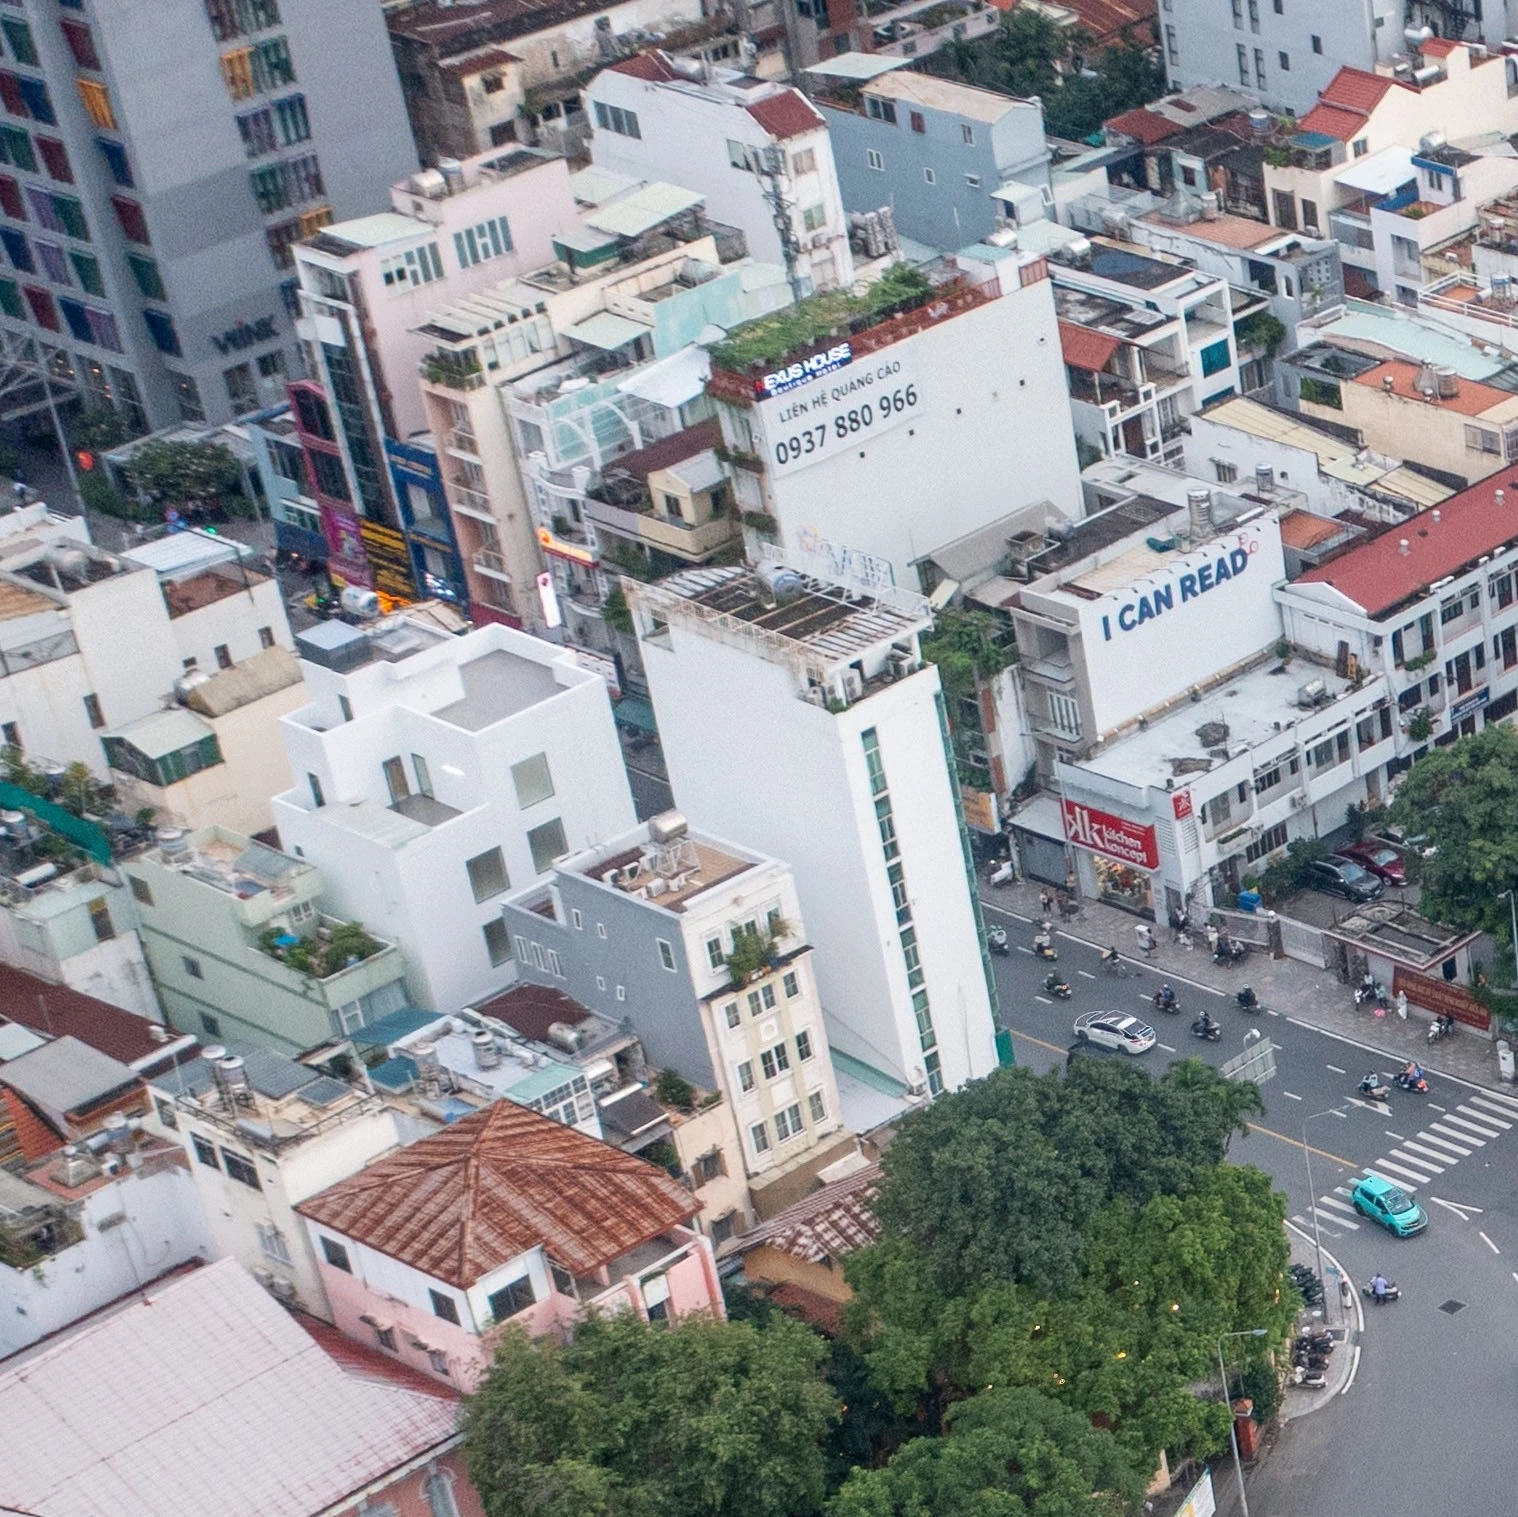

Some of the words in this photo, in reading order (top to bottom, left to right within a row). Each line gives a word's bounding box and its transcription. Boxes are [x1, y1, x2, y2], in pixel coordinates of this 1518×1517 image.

[804, 343, 851, 372] HOUSE
[776, 424, 827, 464] 0937
[834, 404, 873, 439] 880
[879, 383, 918, 419] 966
[779, 402, 809, 424] LIÊN
[812, 390, 828, 409] HỆ
[831, 372, 875, 402] QUẢNG
[1102, 614, 1112, 642] I
[1118, 583, 1174, 632] CAN
[1179, 547, 1248, 603] READ
